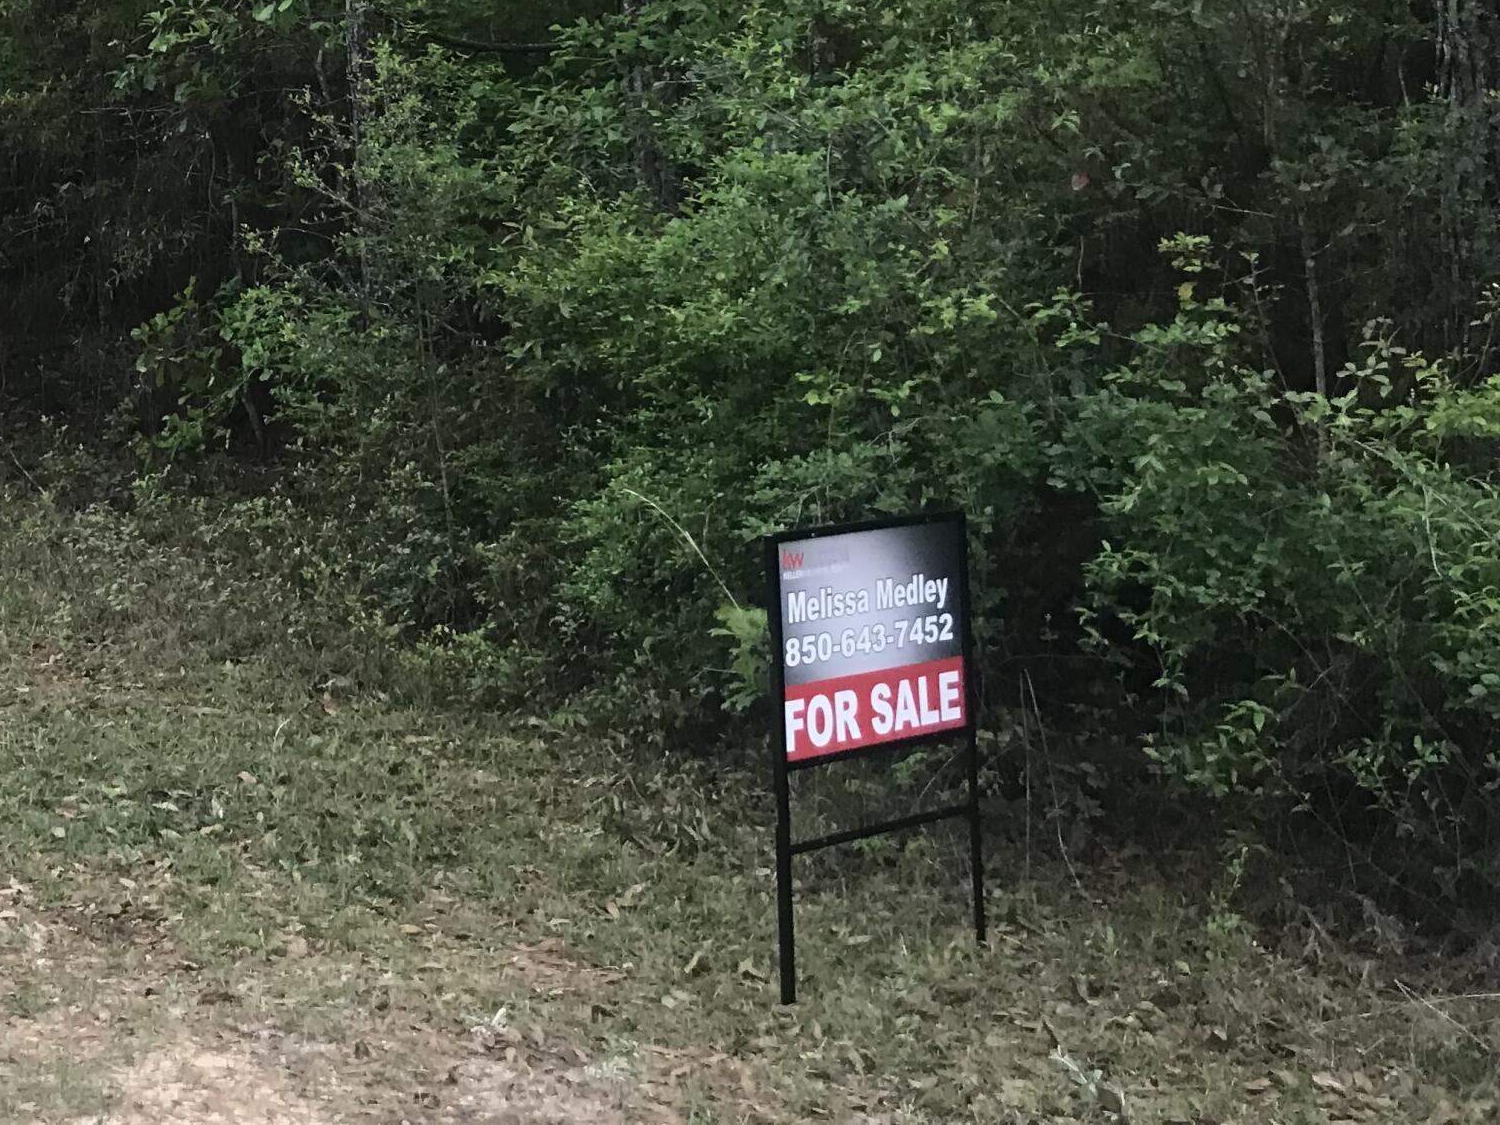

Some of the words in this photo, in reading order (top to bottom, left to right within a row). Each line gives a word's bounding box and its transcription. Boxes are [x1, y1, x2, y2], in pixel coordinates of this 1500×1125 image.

[787, 586, 869, 624] Melissa
[875, 574, 948, 610] Medley
[785, 613, 954, 667] 850-643-7452
[785, 690, 861, 752] FOR
[870, 670, 961, 735] SALE
